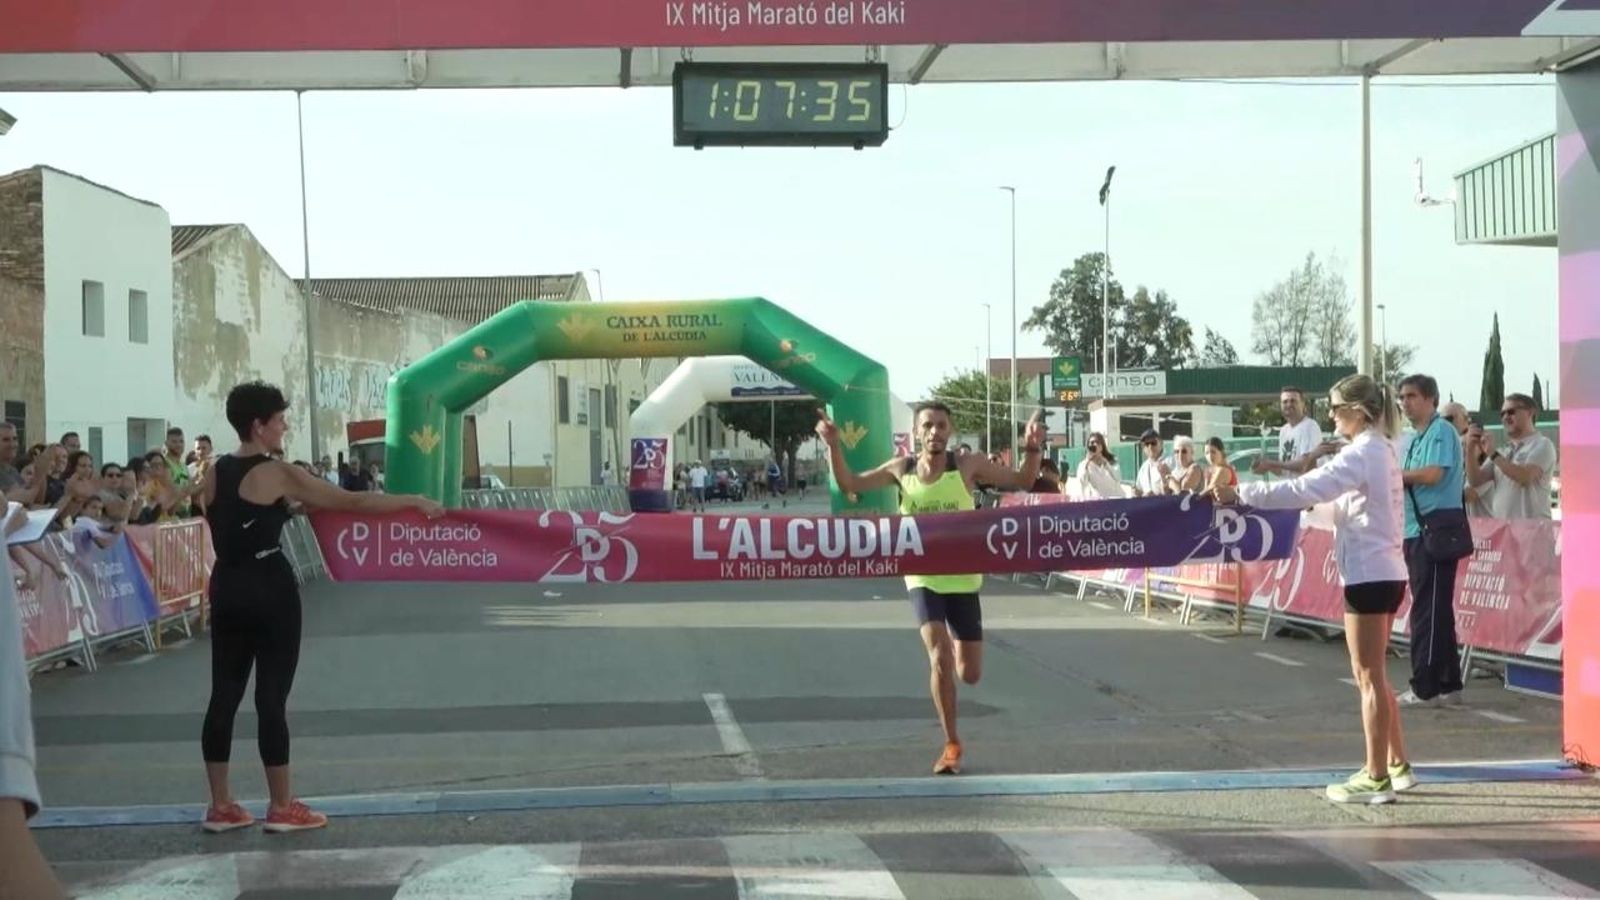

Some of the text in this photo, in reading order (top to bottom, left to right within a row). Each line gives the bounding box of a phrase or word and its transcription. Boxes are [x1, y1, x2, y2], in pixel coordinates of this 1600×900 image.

[666, 0, 906, 31] IX Mitja Marató del Kaki
[709, 80, 872, 122] 1:07:35
[606, 313, 723, 329] CAIXA RURAL
[623, 332, 638, 342] DE
[390, 521, 481, 544] Diputació
[1038, 511, 1130, 538] Diputació
[390, 547, 498, 567] de València
[1038, 536, 1146, 559] de València
[719, 557, 900, 581] IX Mitja Marató del Kaki
